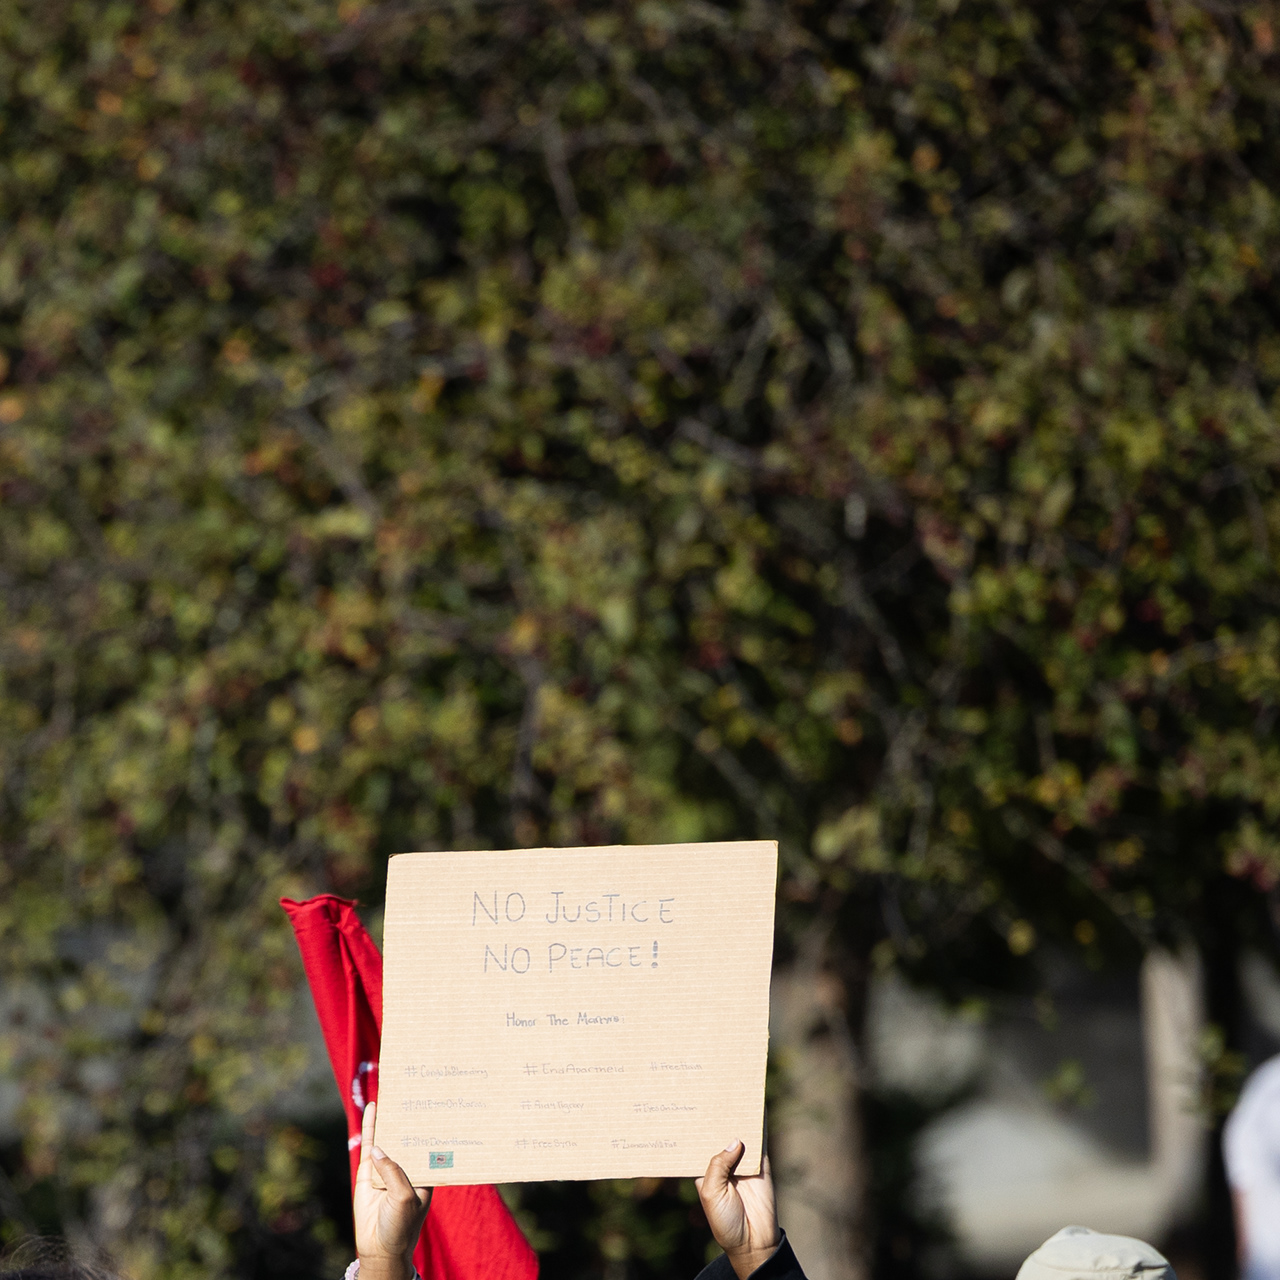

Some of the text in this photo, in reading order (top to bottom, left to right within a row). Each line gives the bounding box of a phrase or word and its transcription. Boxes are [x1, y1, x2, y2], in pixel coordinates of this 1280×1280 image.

[471, 889, 676, 927] NO JUSTICE
[483, 940, 660, 974] NO PEACE!
[505, 1011, 537, 1027] Honor
[546, 1013, 570, 1026] The
